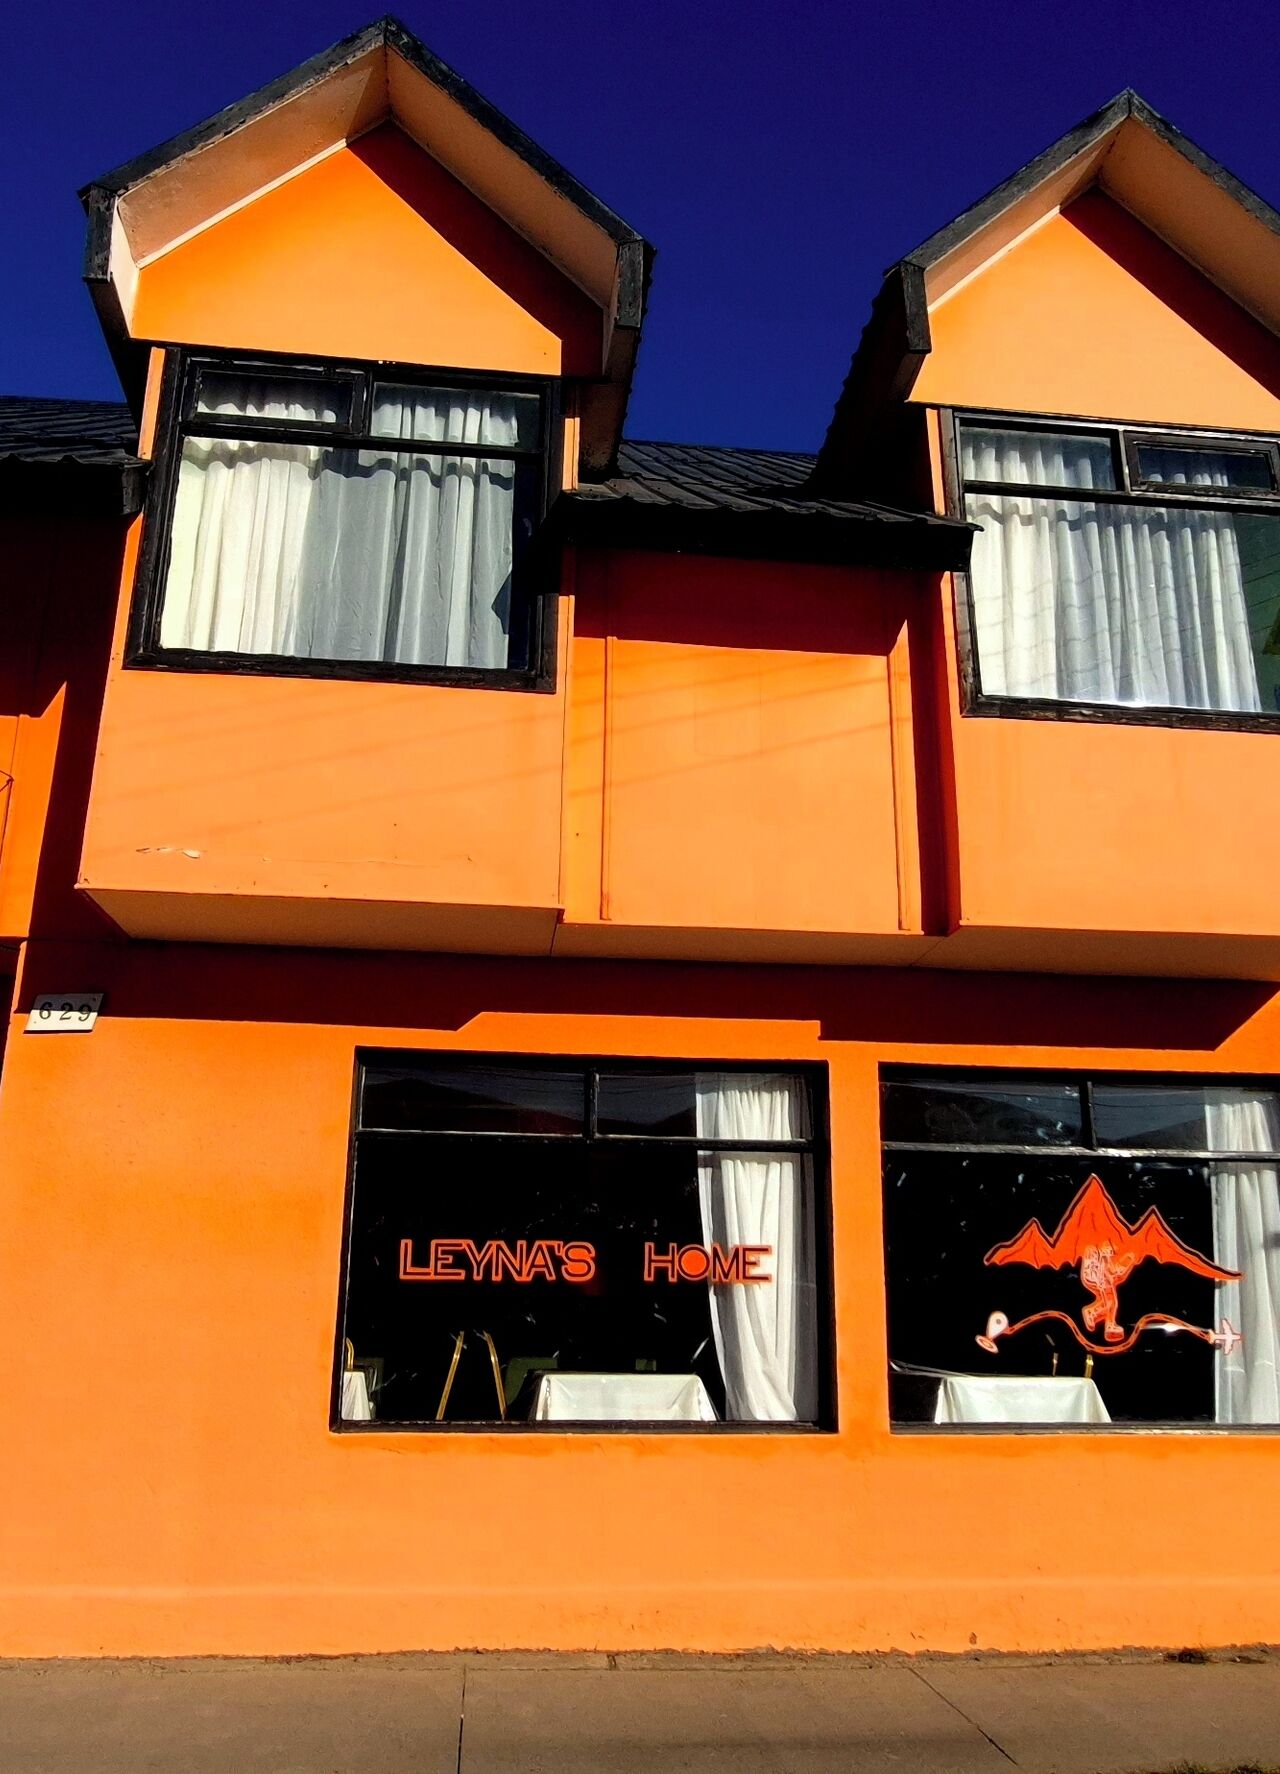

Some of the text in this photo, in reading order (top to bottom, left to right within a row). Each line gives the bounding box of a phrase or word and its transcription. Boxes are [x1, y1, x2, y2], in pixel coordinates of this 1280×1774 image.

[39, 1001, 93, 1022] 629
[399, 1239, 773, 1283] LEYNA'S HOME
